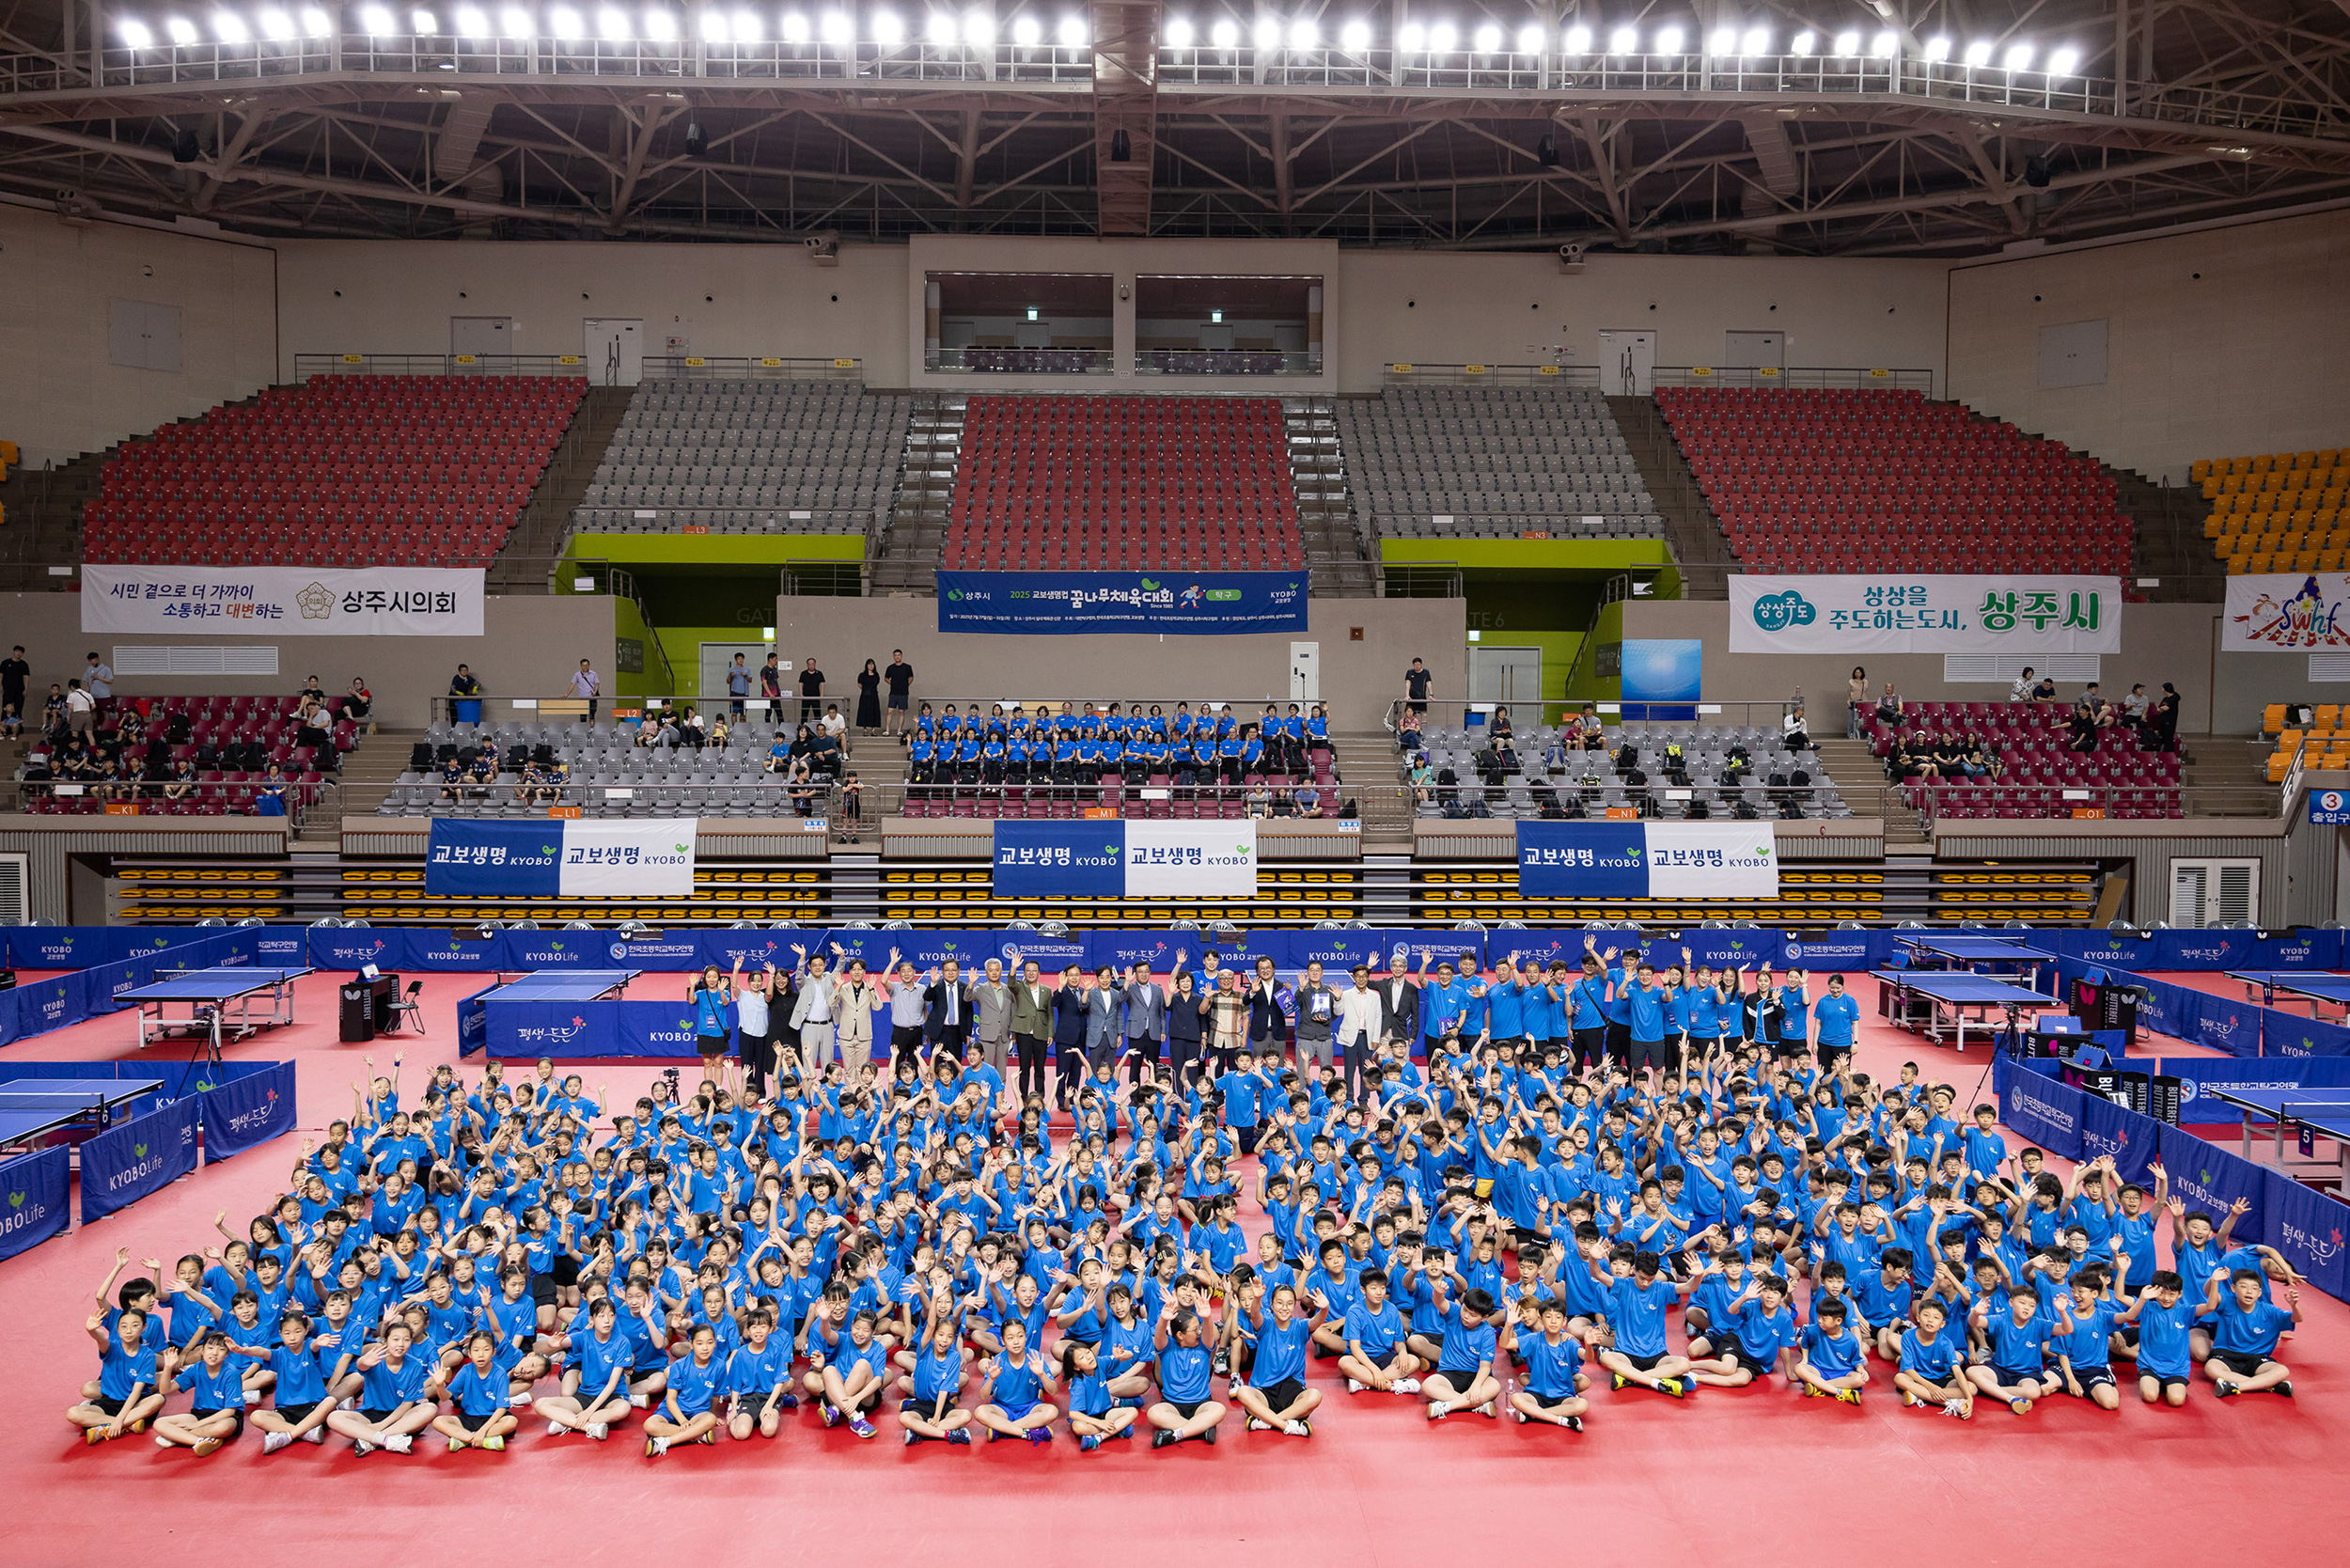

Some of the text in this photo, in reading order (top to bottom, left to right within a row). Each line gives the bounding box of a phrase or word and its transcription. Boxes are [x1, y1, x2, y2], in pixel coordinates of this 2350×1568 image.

[111, 584, 254, 600] 시민 곁으로 더 가까이
[965, 592, 990, 601] 상주시
[1071, 588, 1173, 609] 꿈나무체육대회
[1863, 586, 1927, 606] 상상을
[342, 591, 456, 614] 상주시의회
[163, 603, 284, 619] 소통하고 대변하는
[737, 608, 776, 623] GAT
[1980, 590, 2101, 633] 상주시
[2326, 794, 2338, 808] 3
[565, 809, 575, 818] L1
[1100, 809, 1113, 818] M1
[1622, 809, 1634, 818] N1
[2311, 812, 2350, 823] 출입구
[432, 845, 553, 866] 교보생명 KYOBO
[567, 847, 686, 866] 교보생명 KYOBO
[999, 847, 1117, 867] 교보생명 KYOBO
[1132, 847, 1248, 866] 교보생명 KYOBO
[1525, 848, 1640, 868] 교보생명 KYOBO
[1653, 849, 1769, 868] 교보생명 KYOBO
[334, 949, 353, 958] 평생
[629, 945, 694, 953] 한국초등학교탁구연맹
[1020, 945, 1084, 953] 한국초등학교탁구연맹
[1116, 950, 1136, 960] 평생
[2181, 949, 2201, 959] 평생
[2264, 988, 2271, 996] 11
[43, 999, 65, 1012] KYOBO
[518, 1027, 544, 1041] 평생
[650, 1032, 691, 1042] KYOBO
[229, 1112, 249, 1133] 평생
[2303, 1129, 2310, 1143] 5
[2177, 1176, 2229, 1214] KYOBO 교보생명
[2282, 1222, 2305, 1248] 평생
